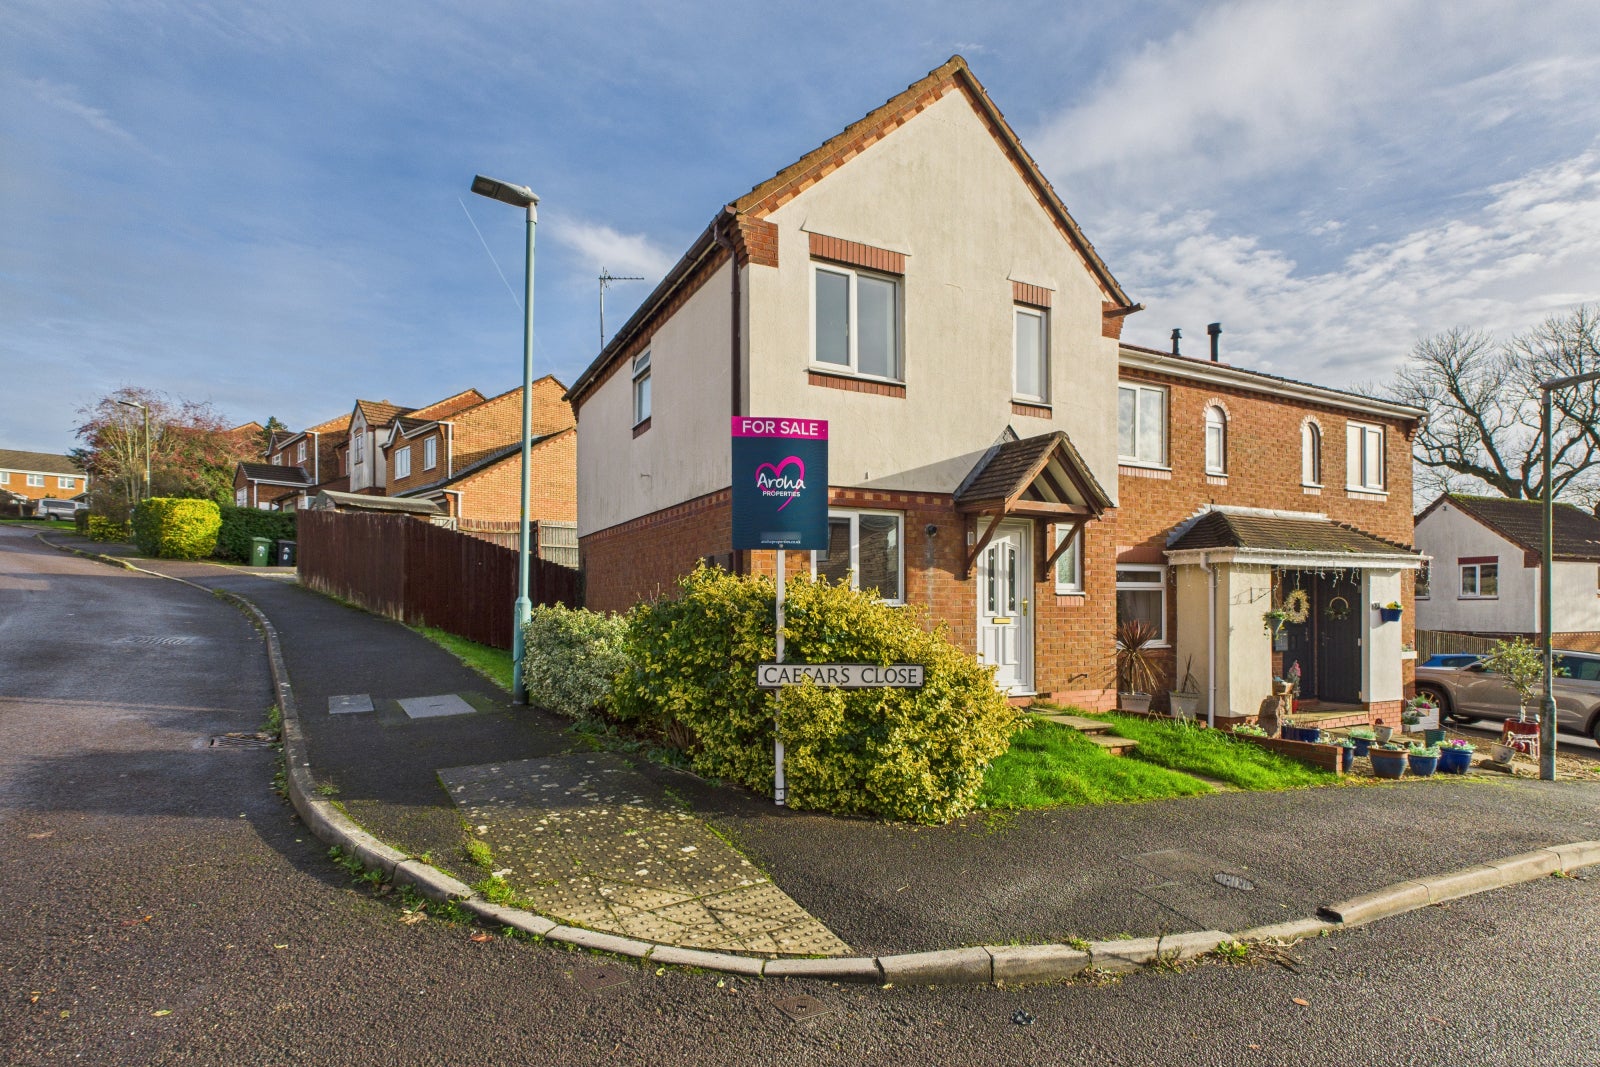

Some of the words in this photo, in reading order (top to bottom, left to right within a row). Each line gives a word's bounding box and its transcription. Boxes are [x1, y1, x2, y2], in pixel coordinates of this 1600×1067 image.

[742, 420, 775, 434] FOR
[780, 421, 818, 436] SALE
[757, 473, 806, 489] Aroha
[764, 667, 850, 684] CAESARS
[861, 667, 917, 684] CLOSE
